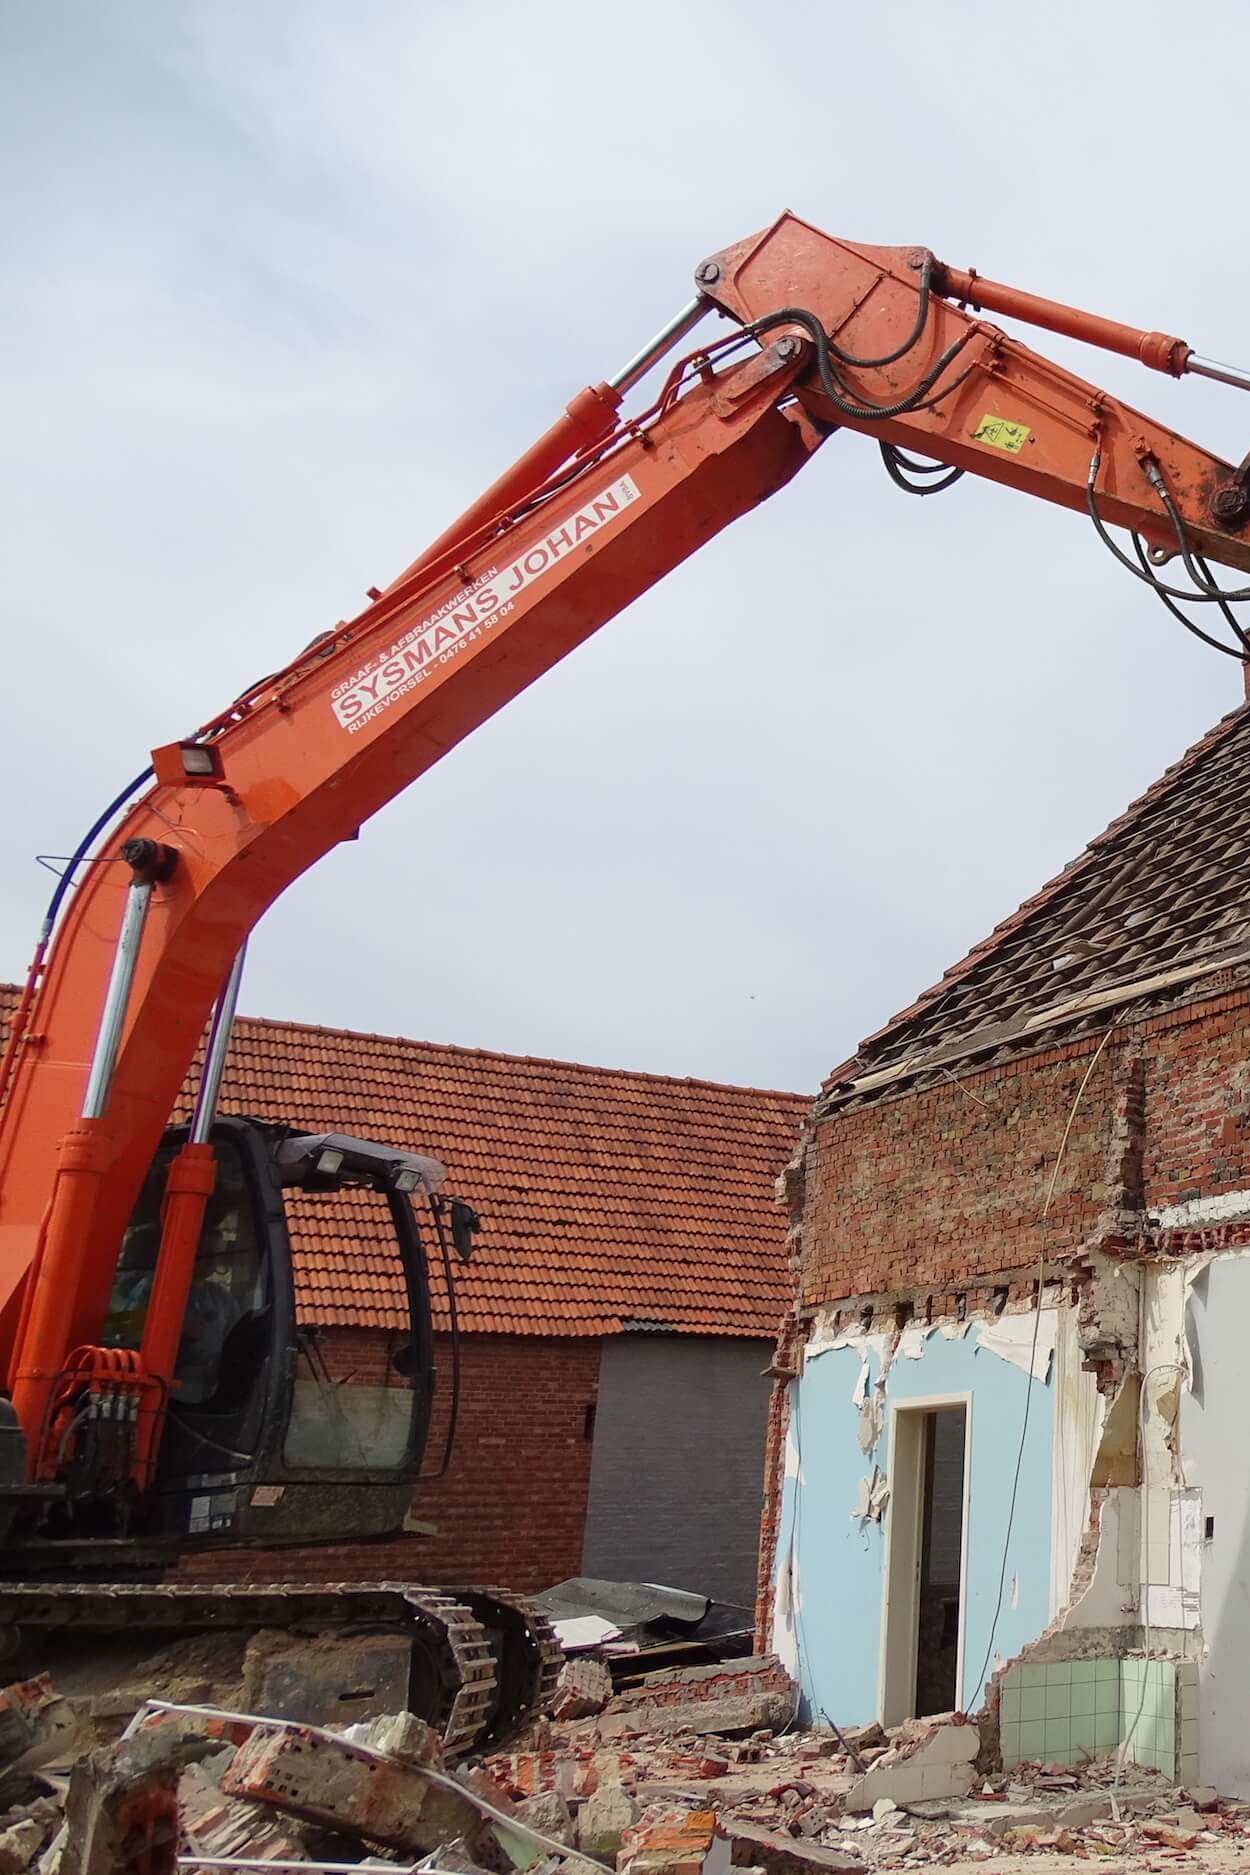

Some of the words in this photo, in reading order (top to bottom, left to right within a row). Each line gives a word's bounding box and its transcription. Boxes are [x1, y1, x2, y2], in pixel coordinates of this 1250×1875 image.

[331, 662, 378, 700] GRAAF-
[379, 653, 389, 663] &
[390, 566, 498, 657] AFBRAAKWERKEN
[339, 588, 499, 719] SYSMANS
[509, 492, 620, 591] JOHAN
[347, 669, 432, 735] RIJKEVORSEL
[440, 641, 467, 664] 0476
[468, 629, 482, 641] 41
[485, 617, 498, 629] 58
[500, 602, 515, 616] 04
